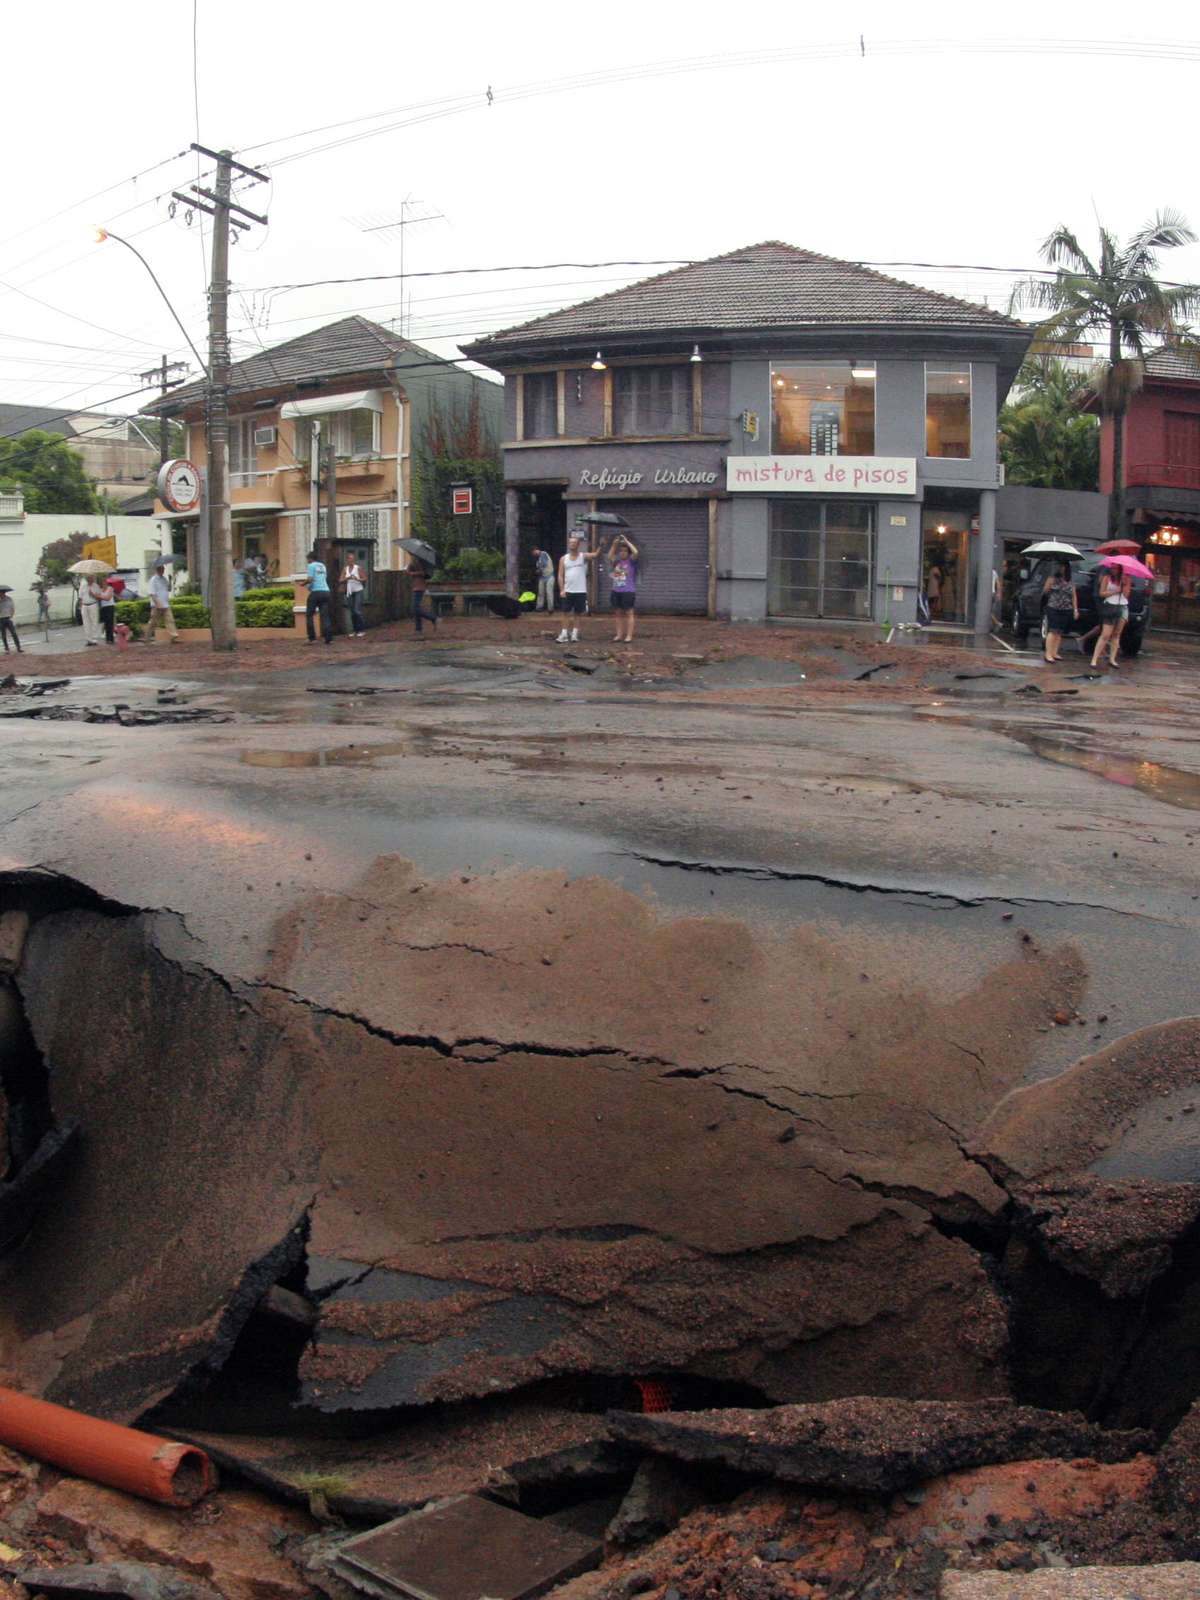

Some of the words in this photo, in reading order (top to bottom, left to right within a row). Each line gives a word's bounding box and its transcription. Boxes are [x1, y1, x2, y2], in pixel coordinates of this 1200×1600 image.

[579, 467, 643, 491] Refúgio
[654, 466, 719, 484] Urbano
[735, 461, 816, 483] mistura
[823, 463, 846, 482] de
[853, 463, 909, 489] pisos
